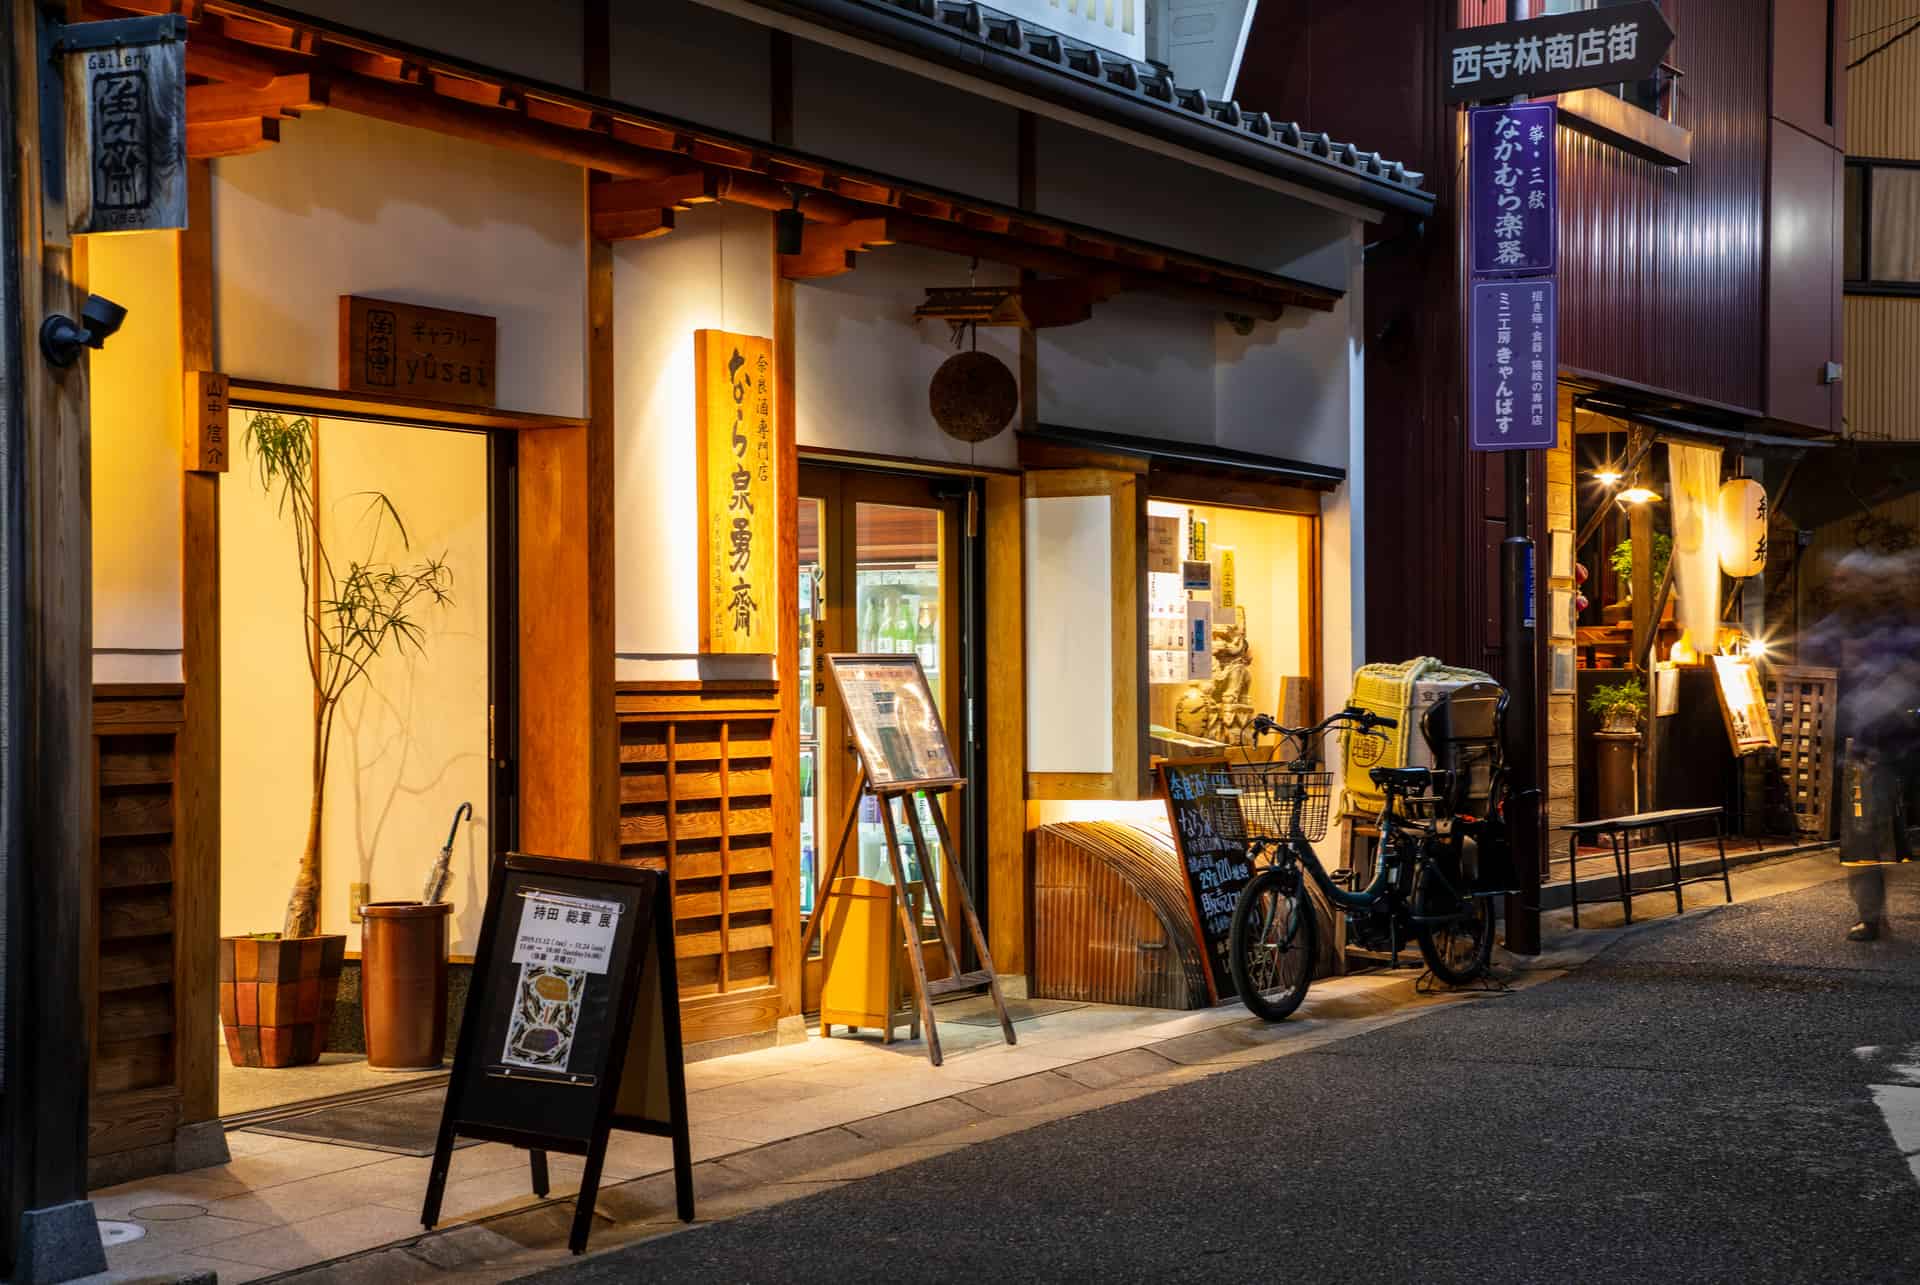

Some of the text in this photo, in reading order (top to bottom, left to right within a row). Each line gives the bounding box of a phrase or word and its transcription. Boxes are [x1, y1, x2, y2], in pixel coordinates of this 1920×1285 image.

[88, 53, 151, 71] Gallery
[1451, 23, 1639, 85] 西寺林商店街
[1493, 113, 1526, 265] なかむら楽器
[533, 905, 559, 921] 持田
